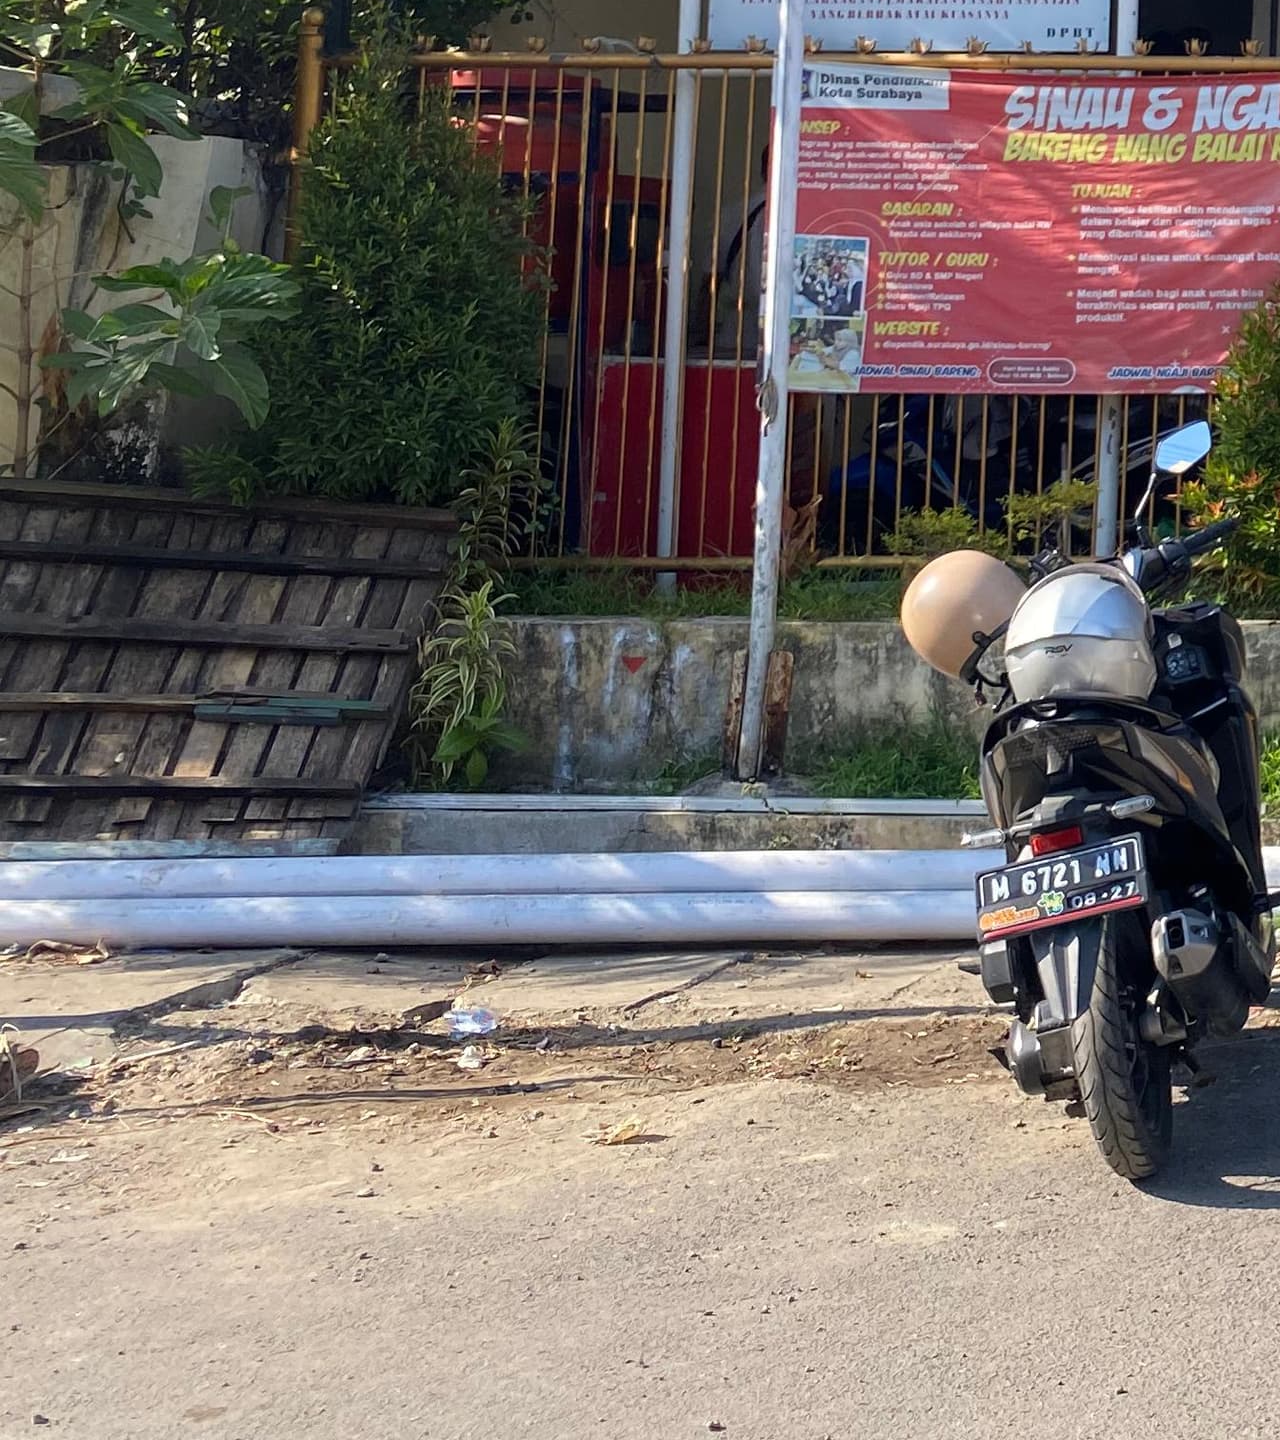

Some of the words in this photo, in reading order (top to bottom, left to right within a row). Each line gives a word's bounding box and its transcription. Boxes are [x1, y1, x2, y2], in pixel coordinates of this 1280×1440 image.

[820, 72, 860, 85] Dinas
[864, 73, 944, 87] Pendidikan
[819, 87, 852, 98] Kota
[857, 87, 923, 101] Surabaya
[1004, 85, 1134, 132] SINAU
[1142, 87, 1183, 131] &
[800, 120, 841, 135] NSEP
[1003, 132, 1108, 162] BARENG
[1112, 133, 1187, 164] NANG
[1192, 133, 1265, 163] BALAI
[1072, 183, 1134, 199] TUJUAN
[881, 201, 954, 217] SASARAN
[878, 251, 929, 266] TUTOR
[946, 252, 989, 267] GURU
[873, 321, 940, 336] WEBSITE
[1109, 366, 1153, 378] JADWAL
[1156, 366, 1190, 378] NGAJI
[991, 875, 1010, 904] M
[1021, 859, 1081, 895] 6721
